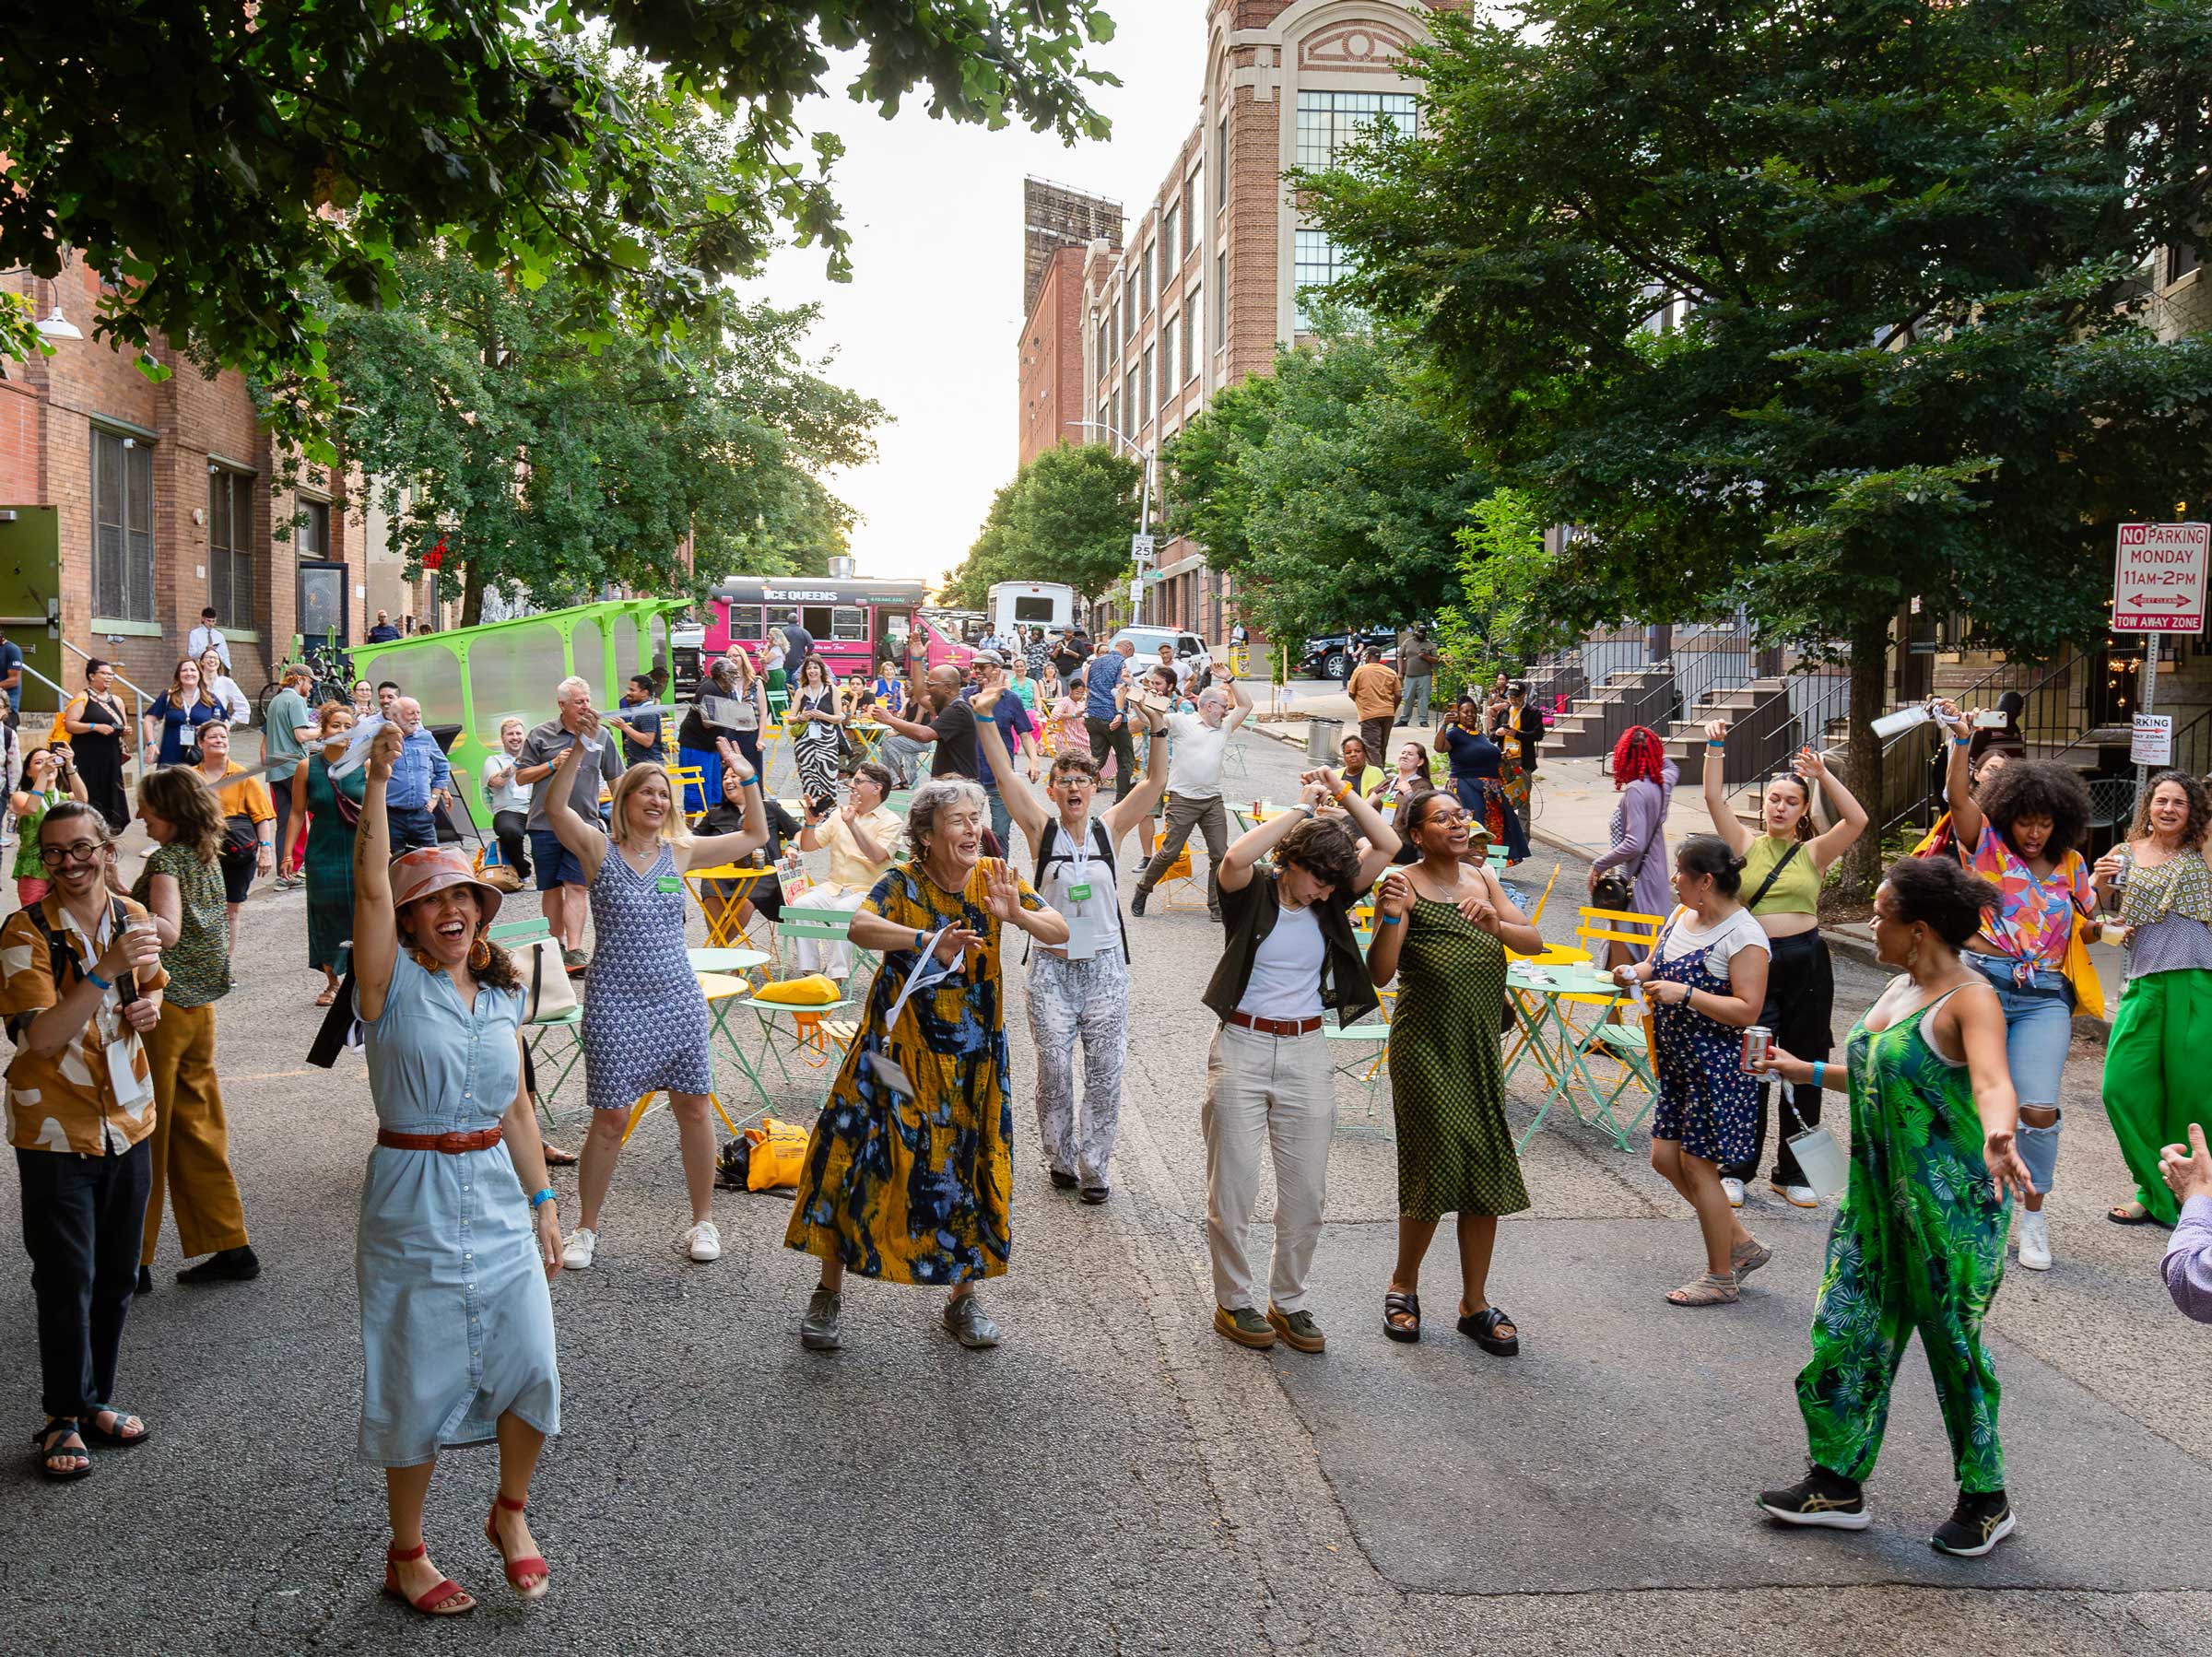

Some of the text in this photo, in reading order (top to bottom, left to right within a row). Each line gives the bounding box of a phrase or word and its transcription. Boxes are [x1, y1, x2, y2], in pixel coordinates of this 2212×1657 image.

[2123, 529, 2204, 544] NO PARKING
[1135, 546, 1150, 556] 25
[2131, 550, 2194, 563] MONDAY
[2124, 570, 2196, 585] 11AM-2PM
[763, 590, 838, 601] ICE QUEENS
[2117, 617, 2199, 628] TOW AWAY ZONE
